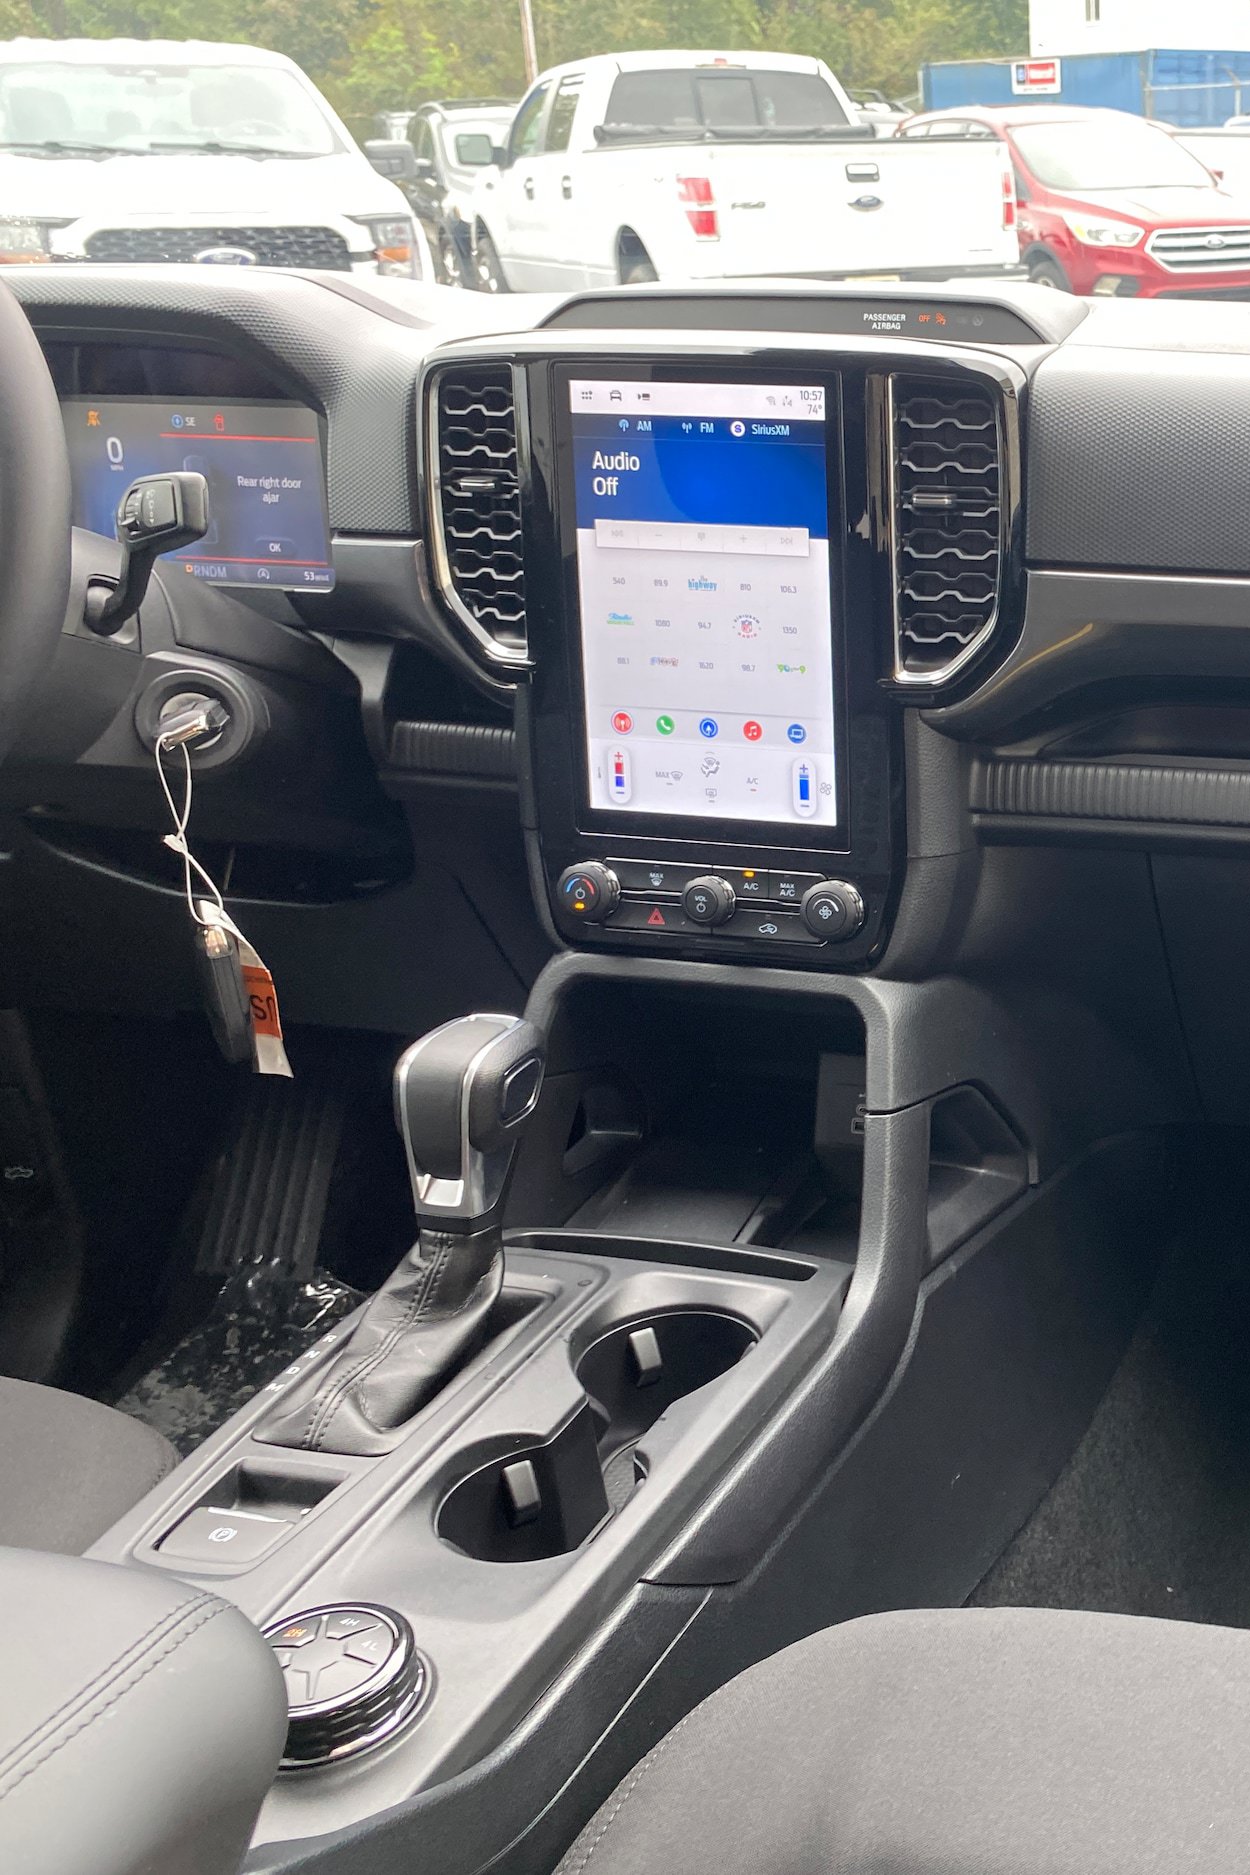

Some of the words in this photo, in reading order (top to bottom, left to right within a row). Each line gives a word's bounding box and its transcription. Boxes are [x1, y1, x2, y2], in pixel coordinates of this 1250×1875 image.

[863, 314, 906, 322] PASSENGER
[918, 314, 930, 322] OFF
[872, 322, 900, 330] AIRBAG
[800, 390, 822, 401] 10:57
[186, 416, 196, 427] SE
[636, 420, 652, 432] AM
[700, 422, 714, 434] FM
[751, 424, 790, 437] SiriusXM
[106, 436, 124, 464] 0
[592, 450, 640, 472] Audio
[237, 476, 258, 487] Rear
[260, 476, 280, 490] right
[282, 477, 302, 488] door
[592, 476, 619, 496] Off
[262, 491, 280, 504] ajar
[269, 542, 282, 552] OK
[304, 571, 315, 581] 53
[688, 578, 718, 591] highway
[780, 586, 797, 594] 106.3
[782, 626, 798, 634] 1350
[744, 882, 759, 890] A/C
[780, 889, 796, 897] A/C
[322, 1334, 338, 1342] R
[304, 1350, 320, 1358] N
[286, 1366, 300, 1374] D
[264, 1383, 286, 1392] M
[340, 1618, 360, 1626] 4H
[283, 1628, 308, 1638] 2H
[361, 1640, 378, 1651] 4L
